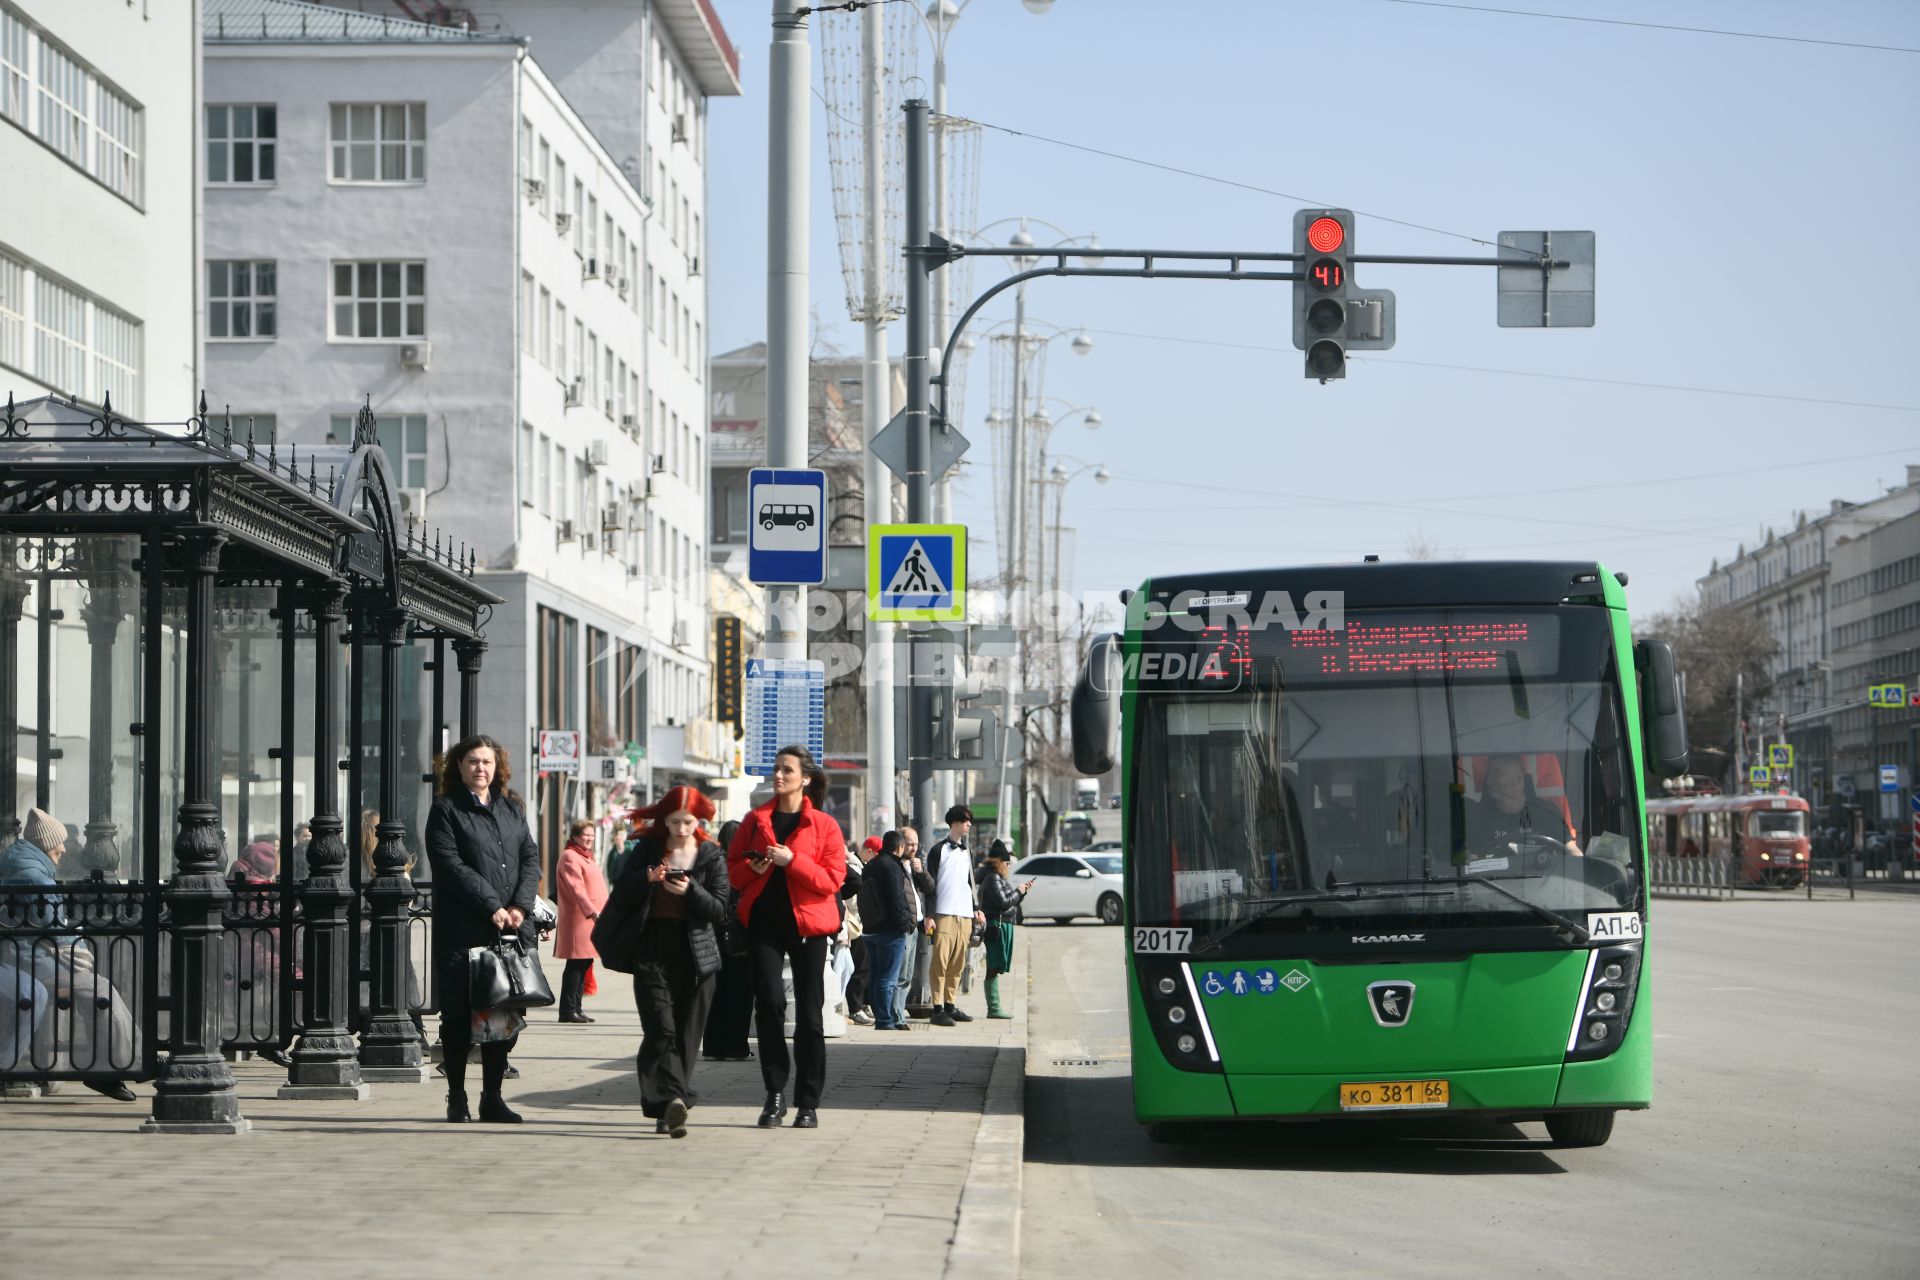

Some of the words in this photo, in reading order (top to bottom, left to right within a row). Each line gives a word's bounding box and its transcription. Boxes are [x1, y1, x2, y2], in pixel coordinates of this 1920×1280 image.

[1315, 266, 1339, 286] 41
[1593, 916, 1639, 936] АП-6
[1136, 930, 1189, 951] 2017
[1352, 933, 1426, 944] KAMAZ
[1287, 976, 1303, 985] КПГ
[1380, 1084, 1414, 1102] 381
[1424, 1082, 1443, 1096] 66
